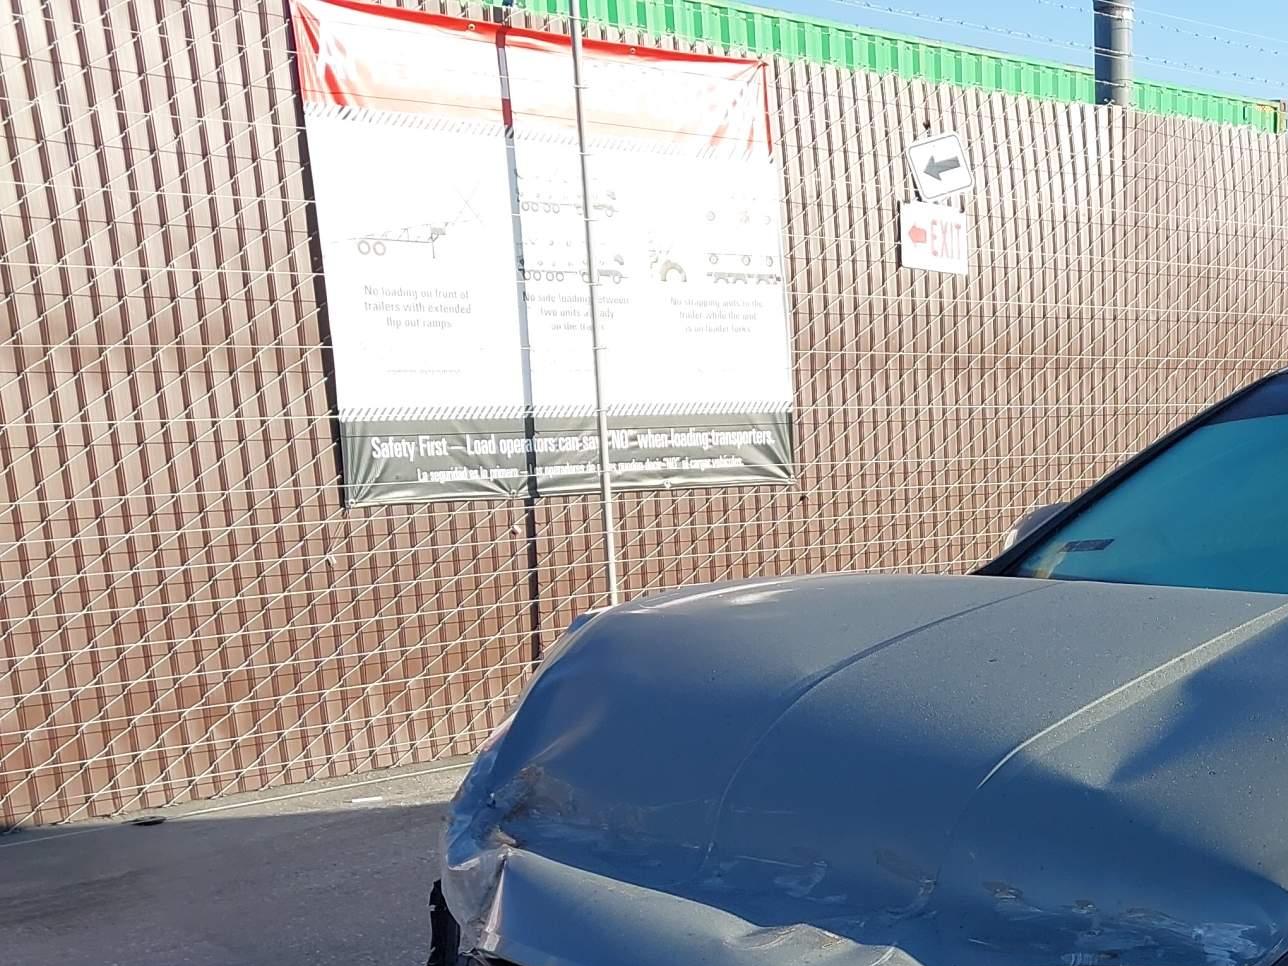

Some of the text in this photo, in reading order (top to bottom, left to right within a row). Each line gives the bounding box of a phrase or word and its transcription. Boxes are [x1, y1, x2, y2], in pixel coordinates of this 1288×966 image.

[931, 219, 961, 260] EXIT
[364, 285, 379, 296] No
[382, 287, 418, 300] loading
[364, 301, 471, 314] trailers with extended
[371, 435, 416, 461] Safety
[419, 435, 449, 457] First
[466, 433, 496, 455] Load
[499, 436, 556, 458] operators
[558, 435, 579, 451] can
[637, 428, 667, 448] when
[670, 427, 708, 450] loading
[711, 429, 776, 449] transporters.
